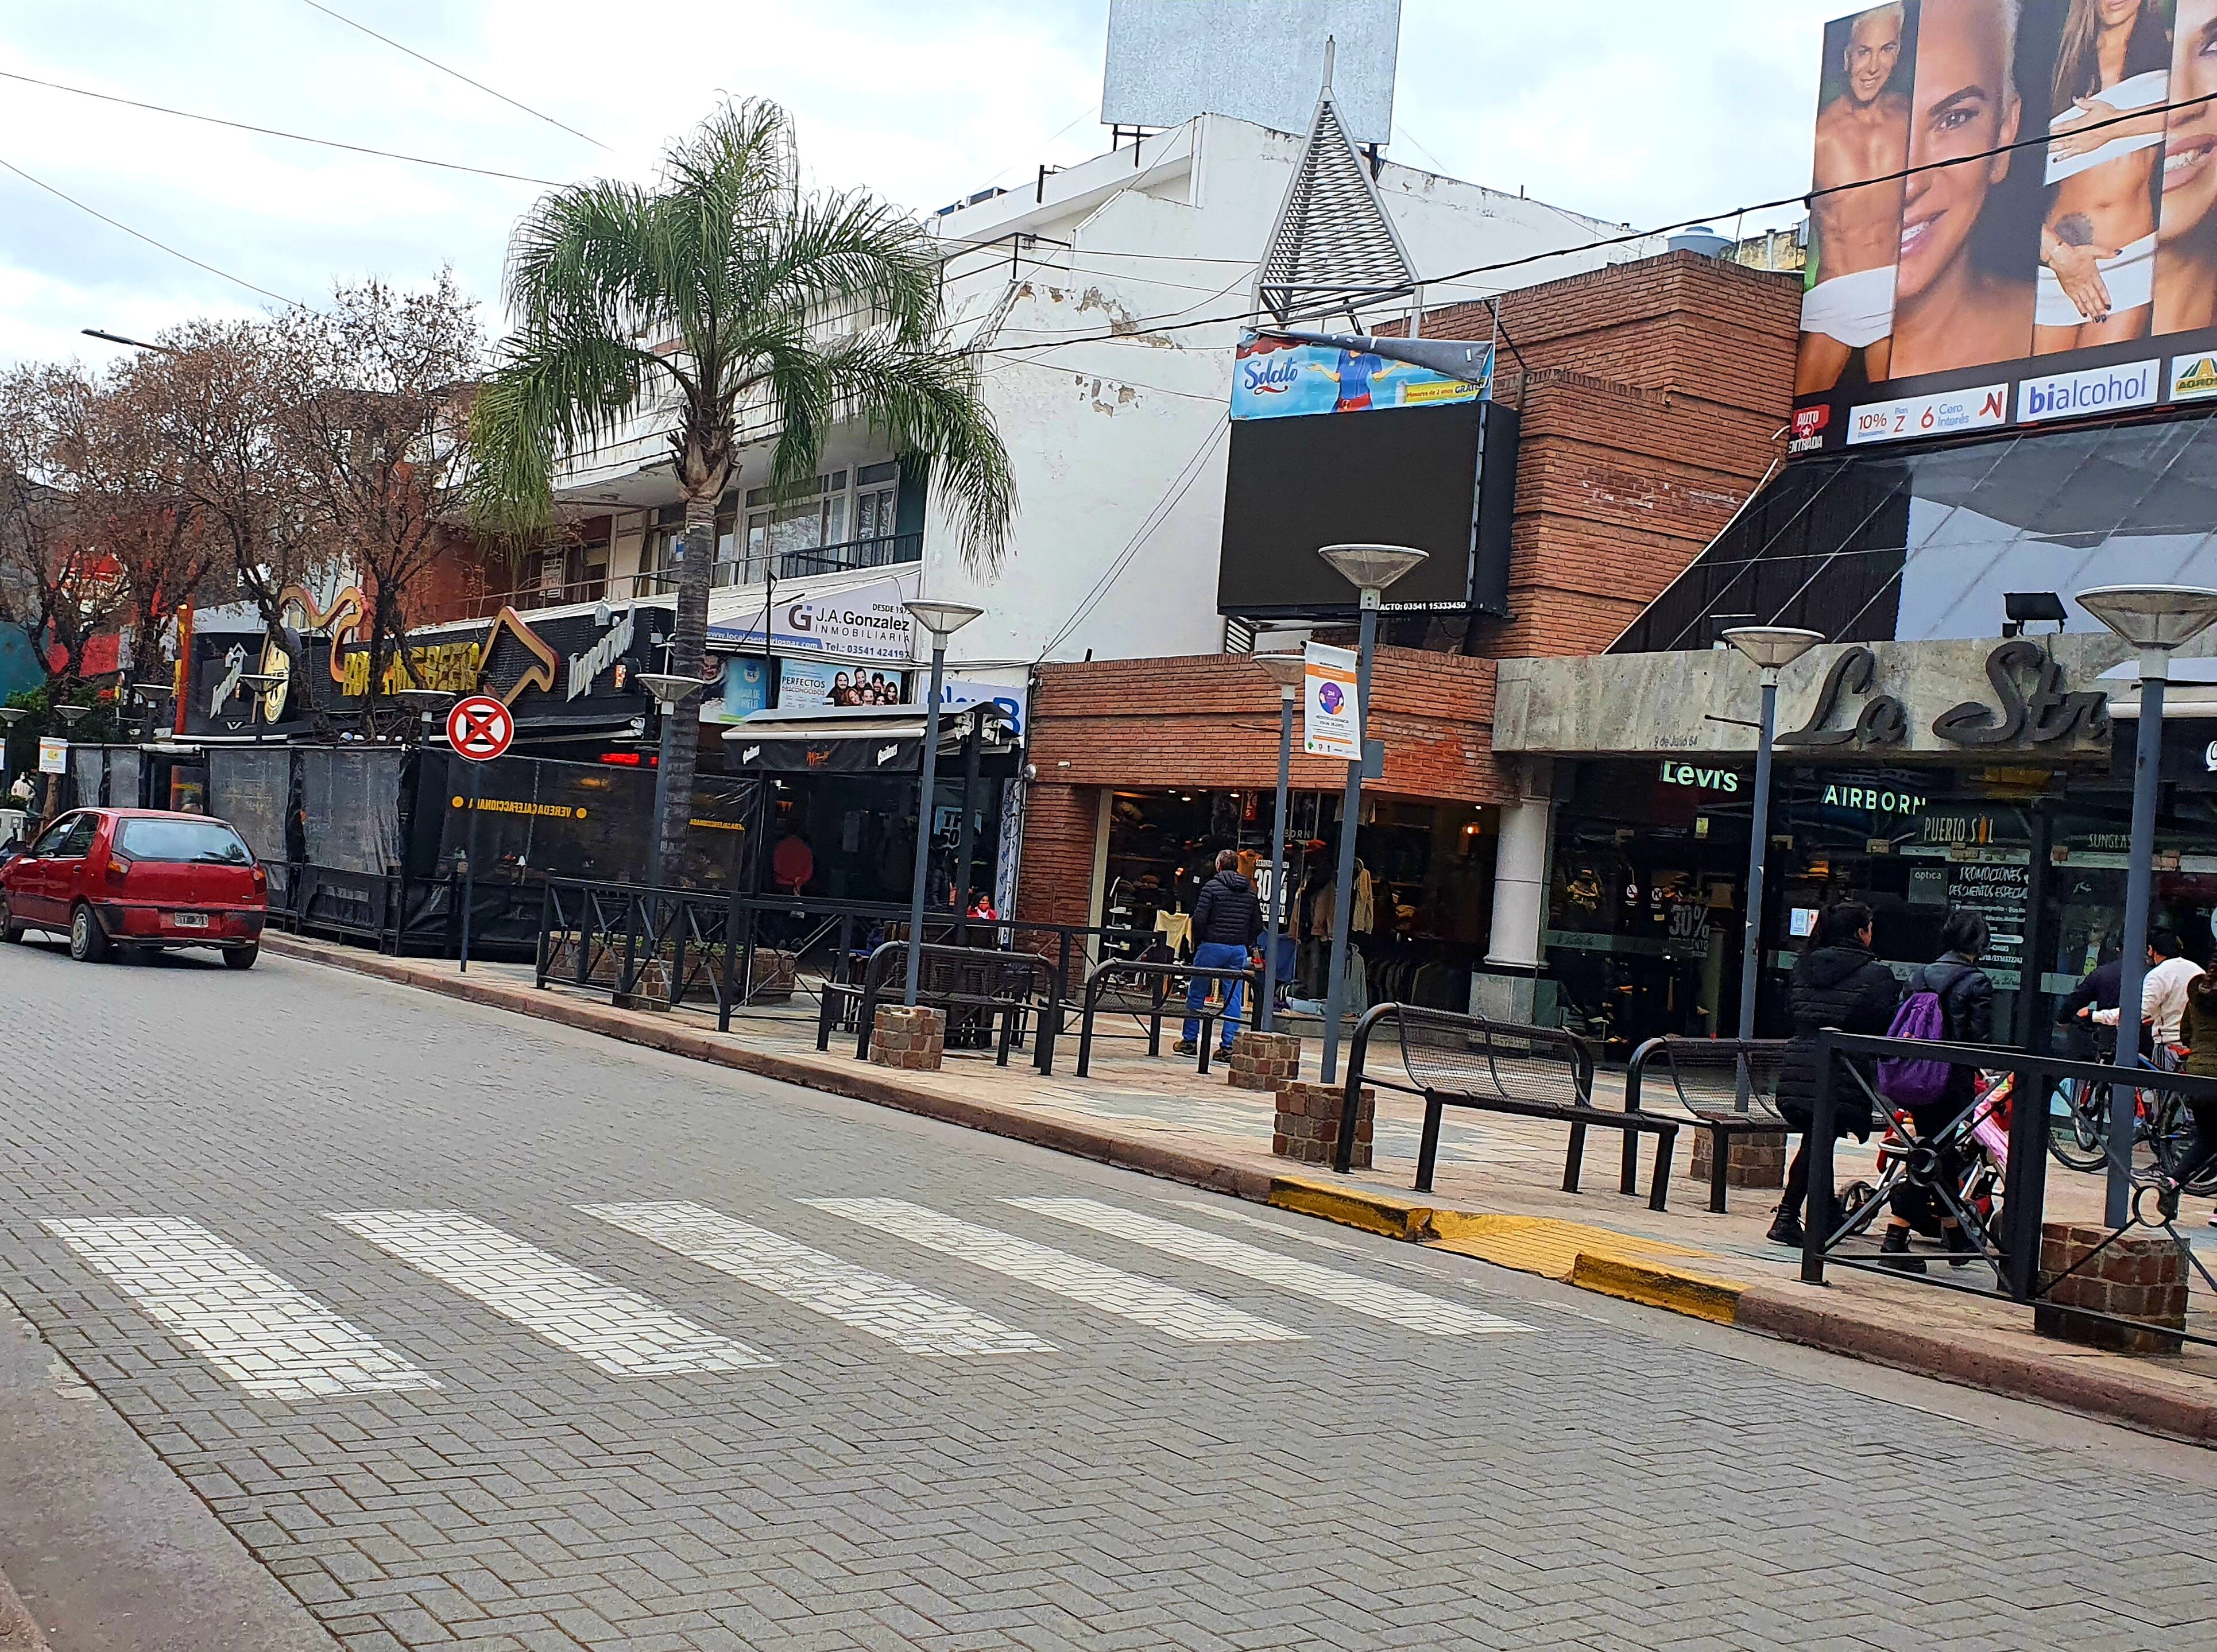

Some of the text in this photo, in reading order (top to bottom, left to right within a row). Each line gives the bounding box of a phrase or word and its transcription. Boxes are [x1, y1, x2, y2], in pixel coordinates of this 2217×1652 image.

[2029, 368, 2146, 415] bialcohol
[2178, 377, 2217, 390] AGRO
[1920, 405, 1934, 428] 6
[1939, 403, 1964, 415] Cero
[1796, 409, 1820, 427] AUTO
[1858, 412, 1887, 430] 10%
[1893, 415, 1906, 432] Z
[1937, 413, 1971, 427] Interés
[872, 603, 894, 613] DESDE
[1403, 602, 1426, 610] 03541
[1429, 601, 1467, 610] 15333450
[815, 624, 910, 643] INMOBILIARIA
[825, 642, 845, 652] Tel.:
[847, 644, 875, 656] 03541
[781, 676, 826, 689] PERFECTOS
[1663, 760, 1738, 792] Levi's
[1924, 817, 1965, 842] PUERTO
[1669, 904, 1710, 939] 30%
